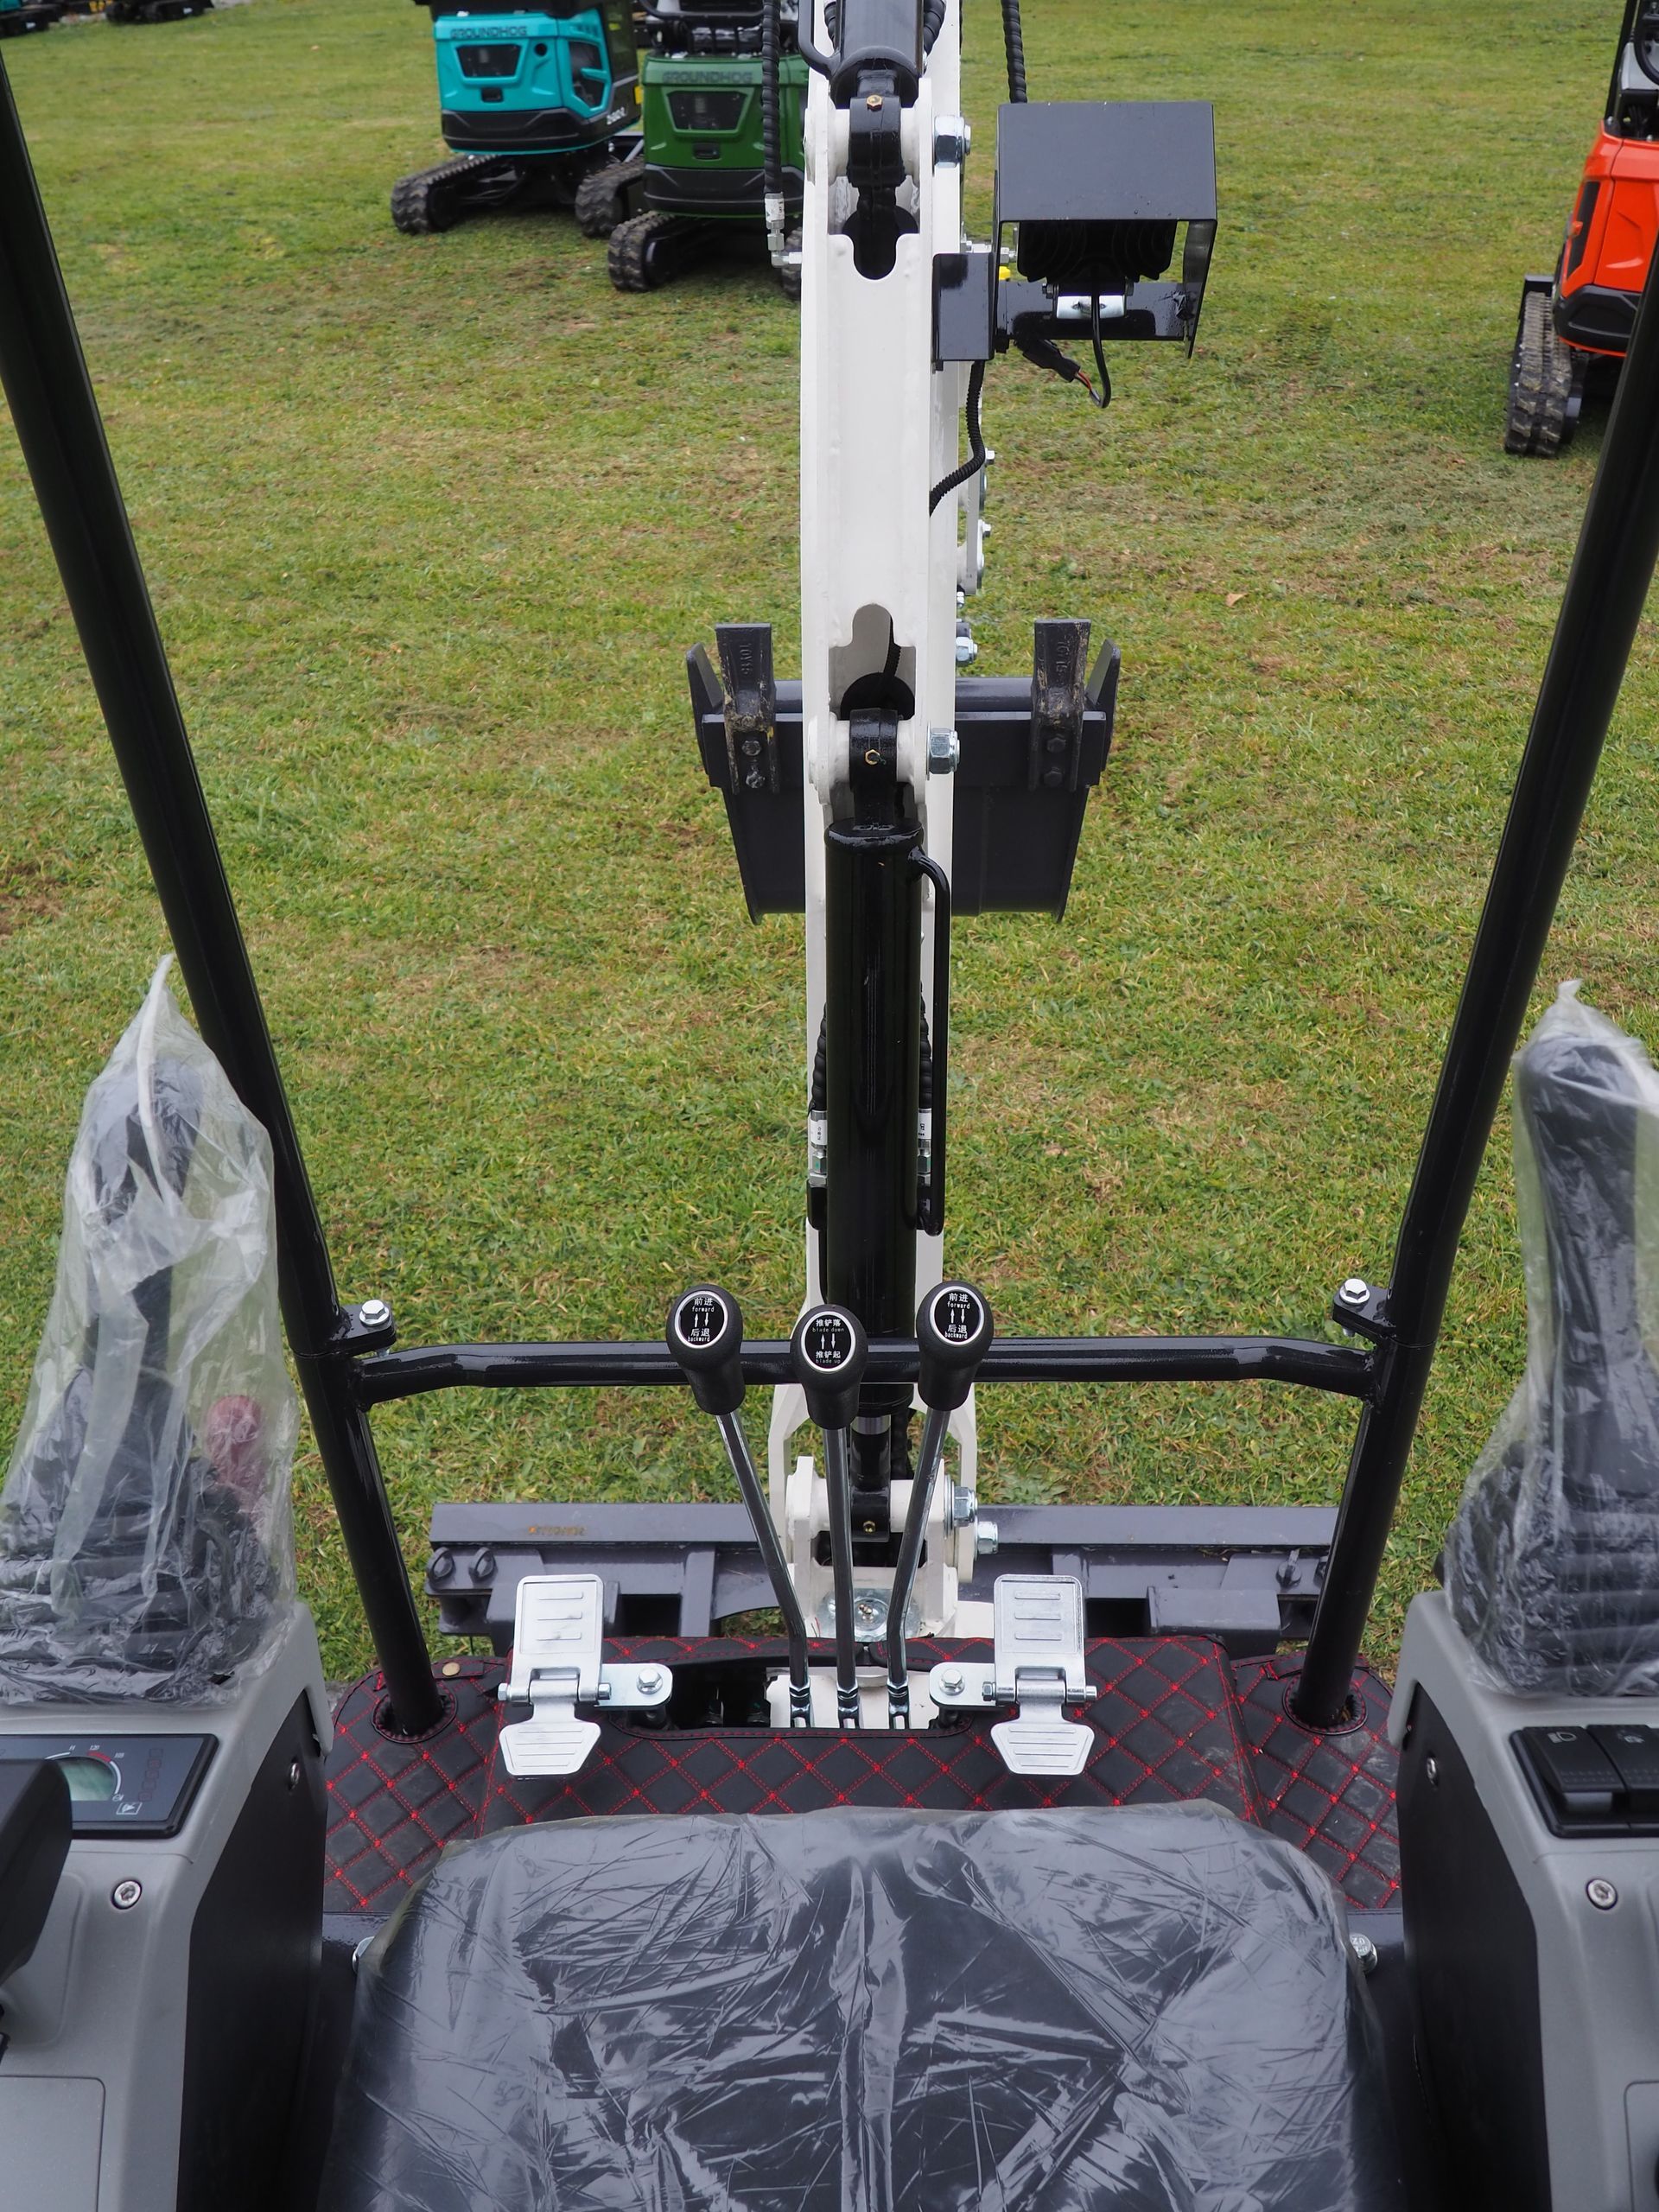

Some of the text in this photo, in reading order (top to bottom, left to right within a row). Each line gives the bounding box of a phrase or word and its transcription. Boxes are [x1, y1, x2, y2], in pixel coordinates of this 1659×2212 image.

[450, 26, 527, 39] GROUNDHOG
[662, 71, 753, 84] GROUNDHOG
[694, 1297, 714, 1306] 前进
[948, 1293, 969, 1302] 前进
[947, 1300, 970, 1309] forward
[690, 1328, 710, 1337] 后退
[947, 1324, 968, 1333] 后退
[944, 1331, 969, 1339] backward
